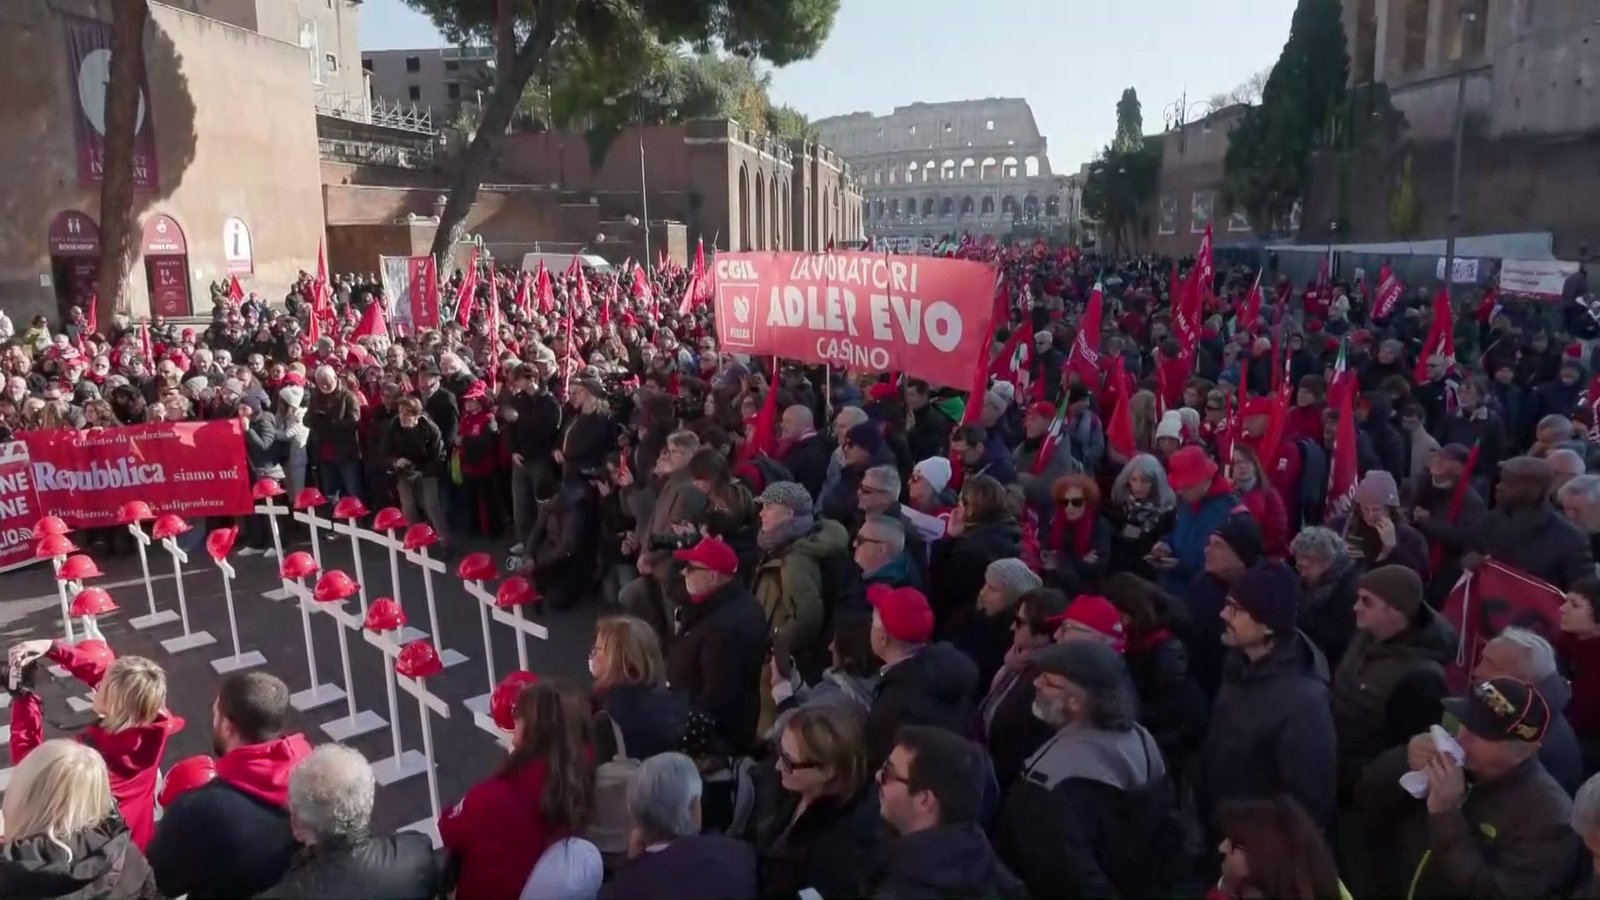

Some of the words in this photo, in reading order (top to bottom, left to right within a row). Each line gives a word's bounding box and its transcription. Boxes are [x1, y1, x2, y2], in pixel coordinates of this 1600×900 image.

[58, 243, 95, 251] BOOKSHOP
[717, 259, 759, 280] CGIL
[790, 252, 918, 293] LAVORATORI
[766, 285, 859, 337] ADLER
[870, 294, 963, 352] EVO
[816, 337, 889, 370] CASINO
[33, 456, 166, 496] Repubblica
[173, 468, 215, 481] siamo
